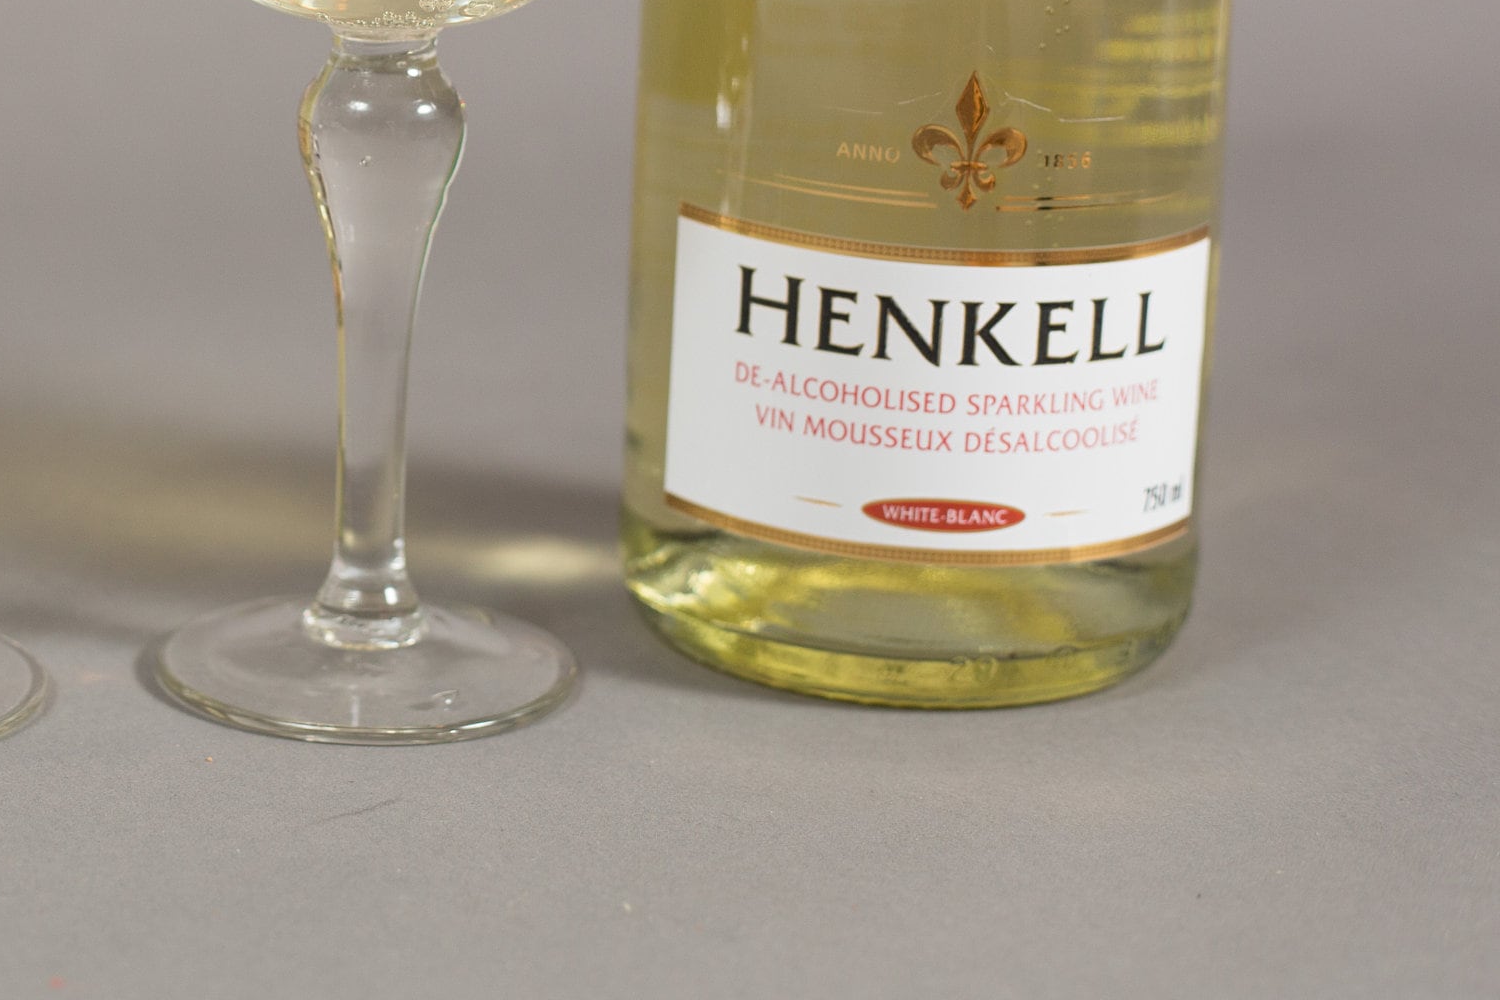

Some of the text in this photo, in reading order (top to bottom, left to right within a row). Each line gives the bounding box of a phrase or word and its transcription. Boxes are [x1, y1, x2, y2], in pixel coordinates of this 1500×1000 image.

[835, 142, 1093, 169] ANNO 1856
[734, 264, 1167, 368] HENKELL
[734, 361, 1158, 416] DE-ALCOHOLISED SPARKLING WINE
[755, 404, 1139, 453] VIN MOUSSEUX DÉSALCOOLISÉ
[882, 504, 1008, 525] WHITE-BLANC
[1142, 482, 1168, 512] 750
